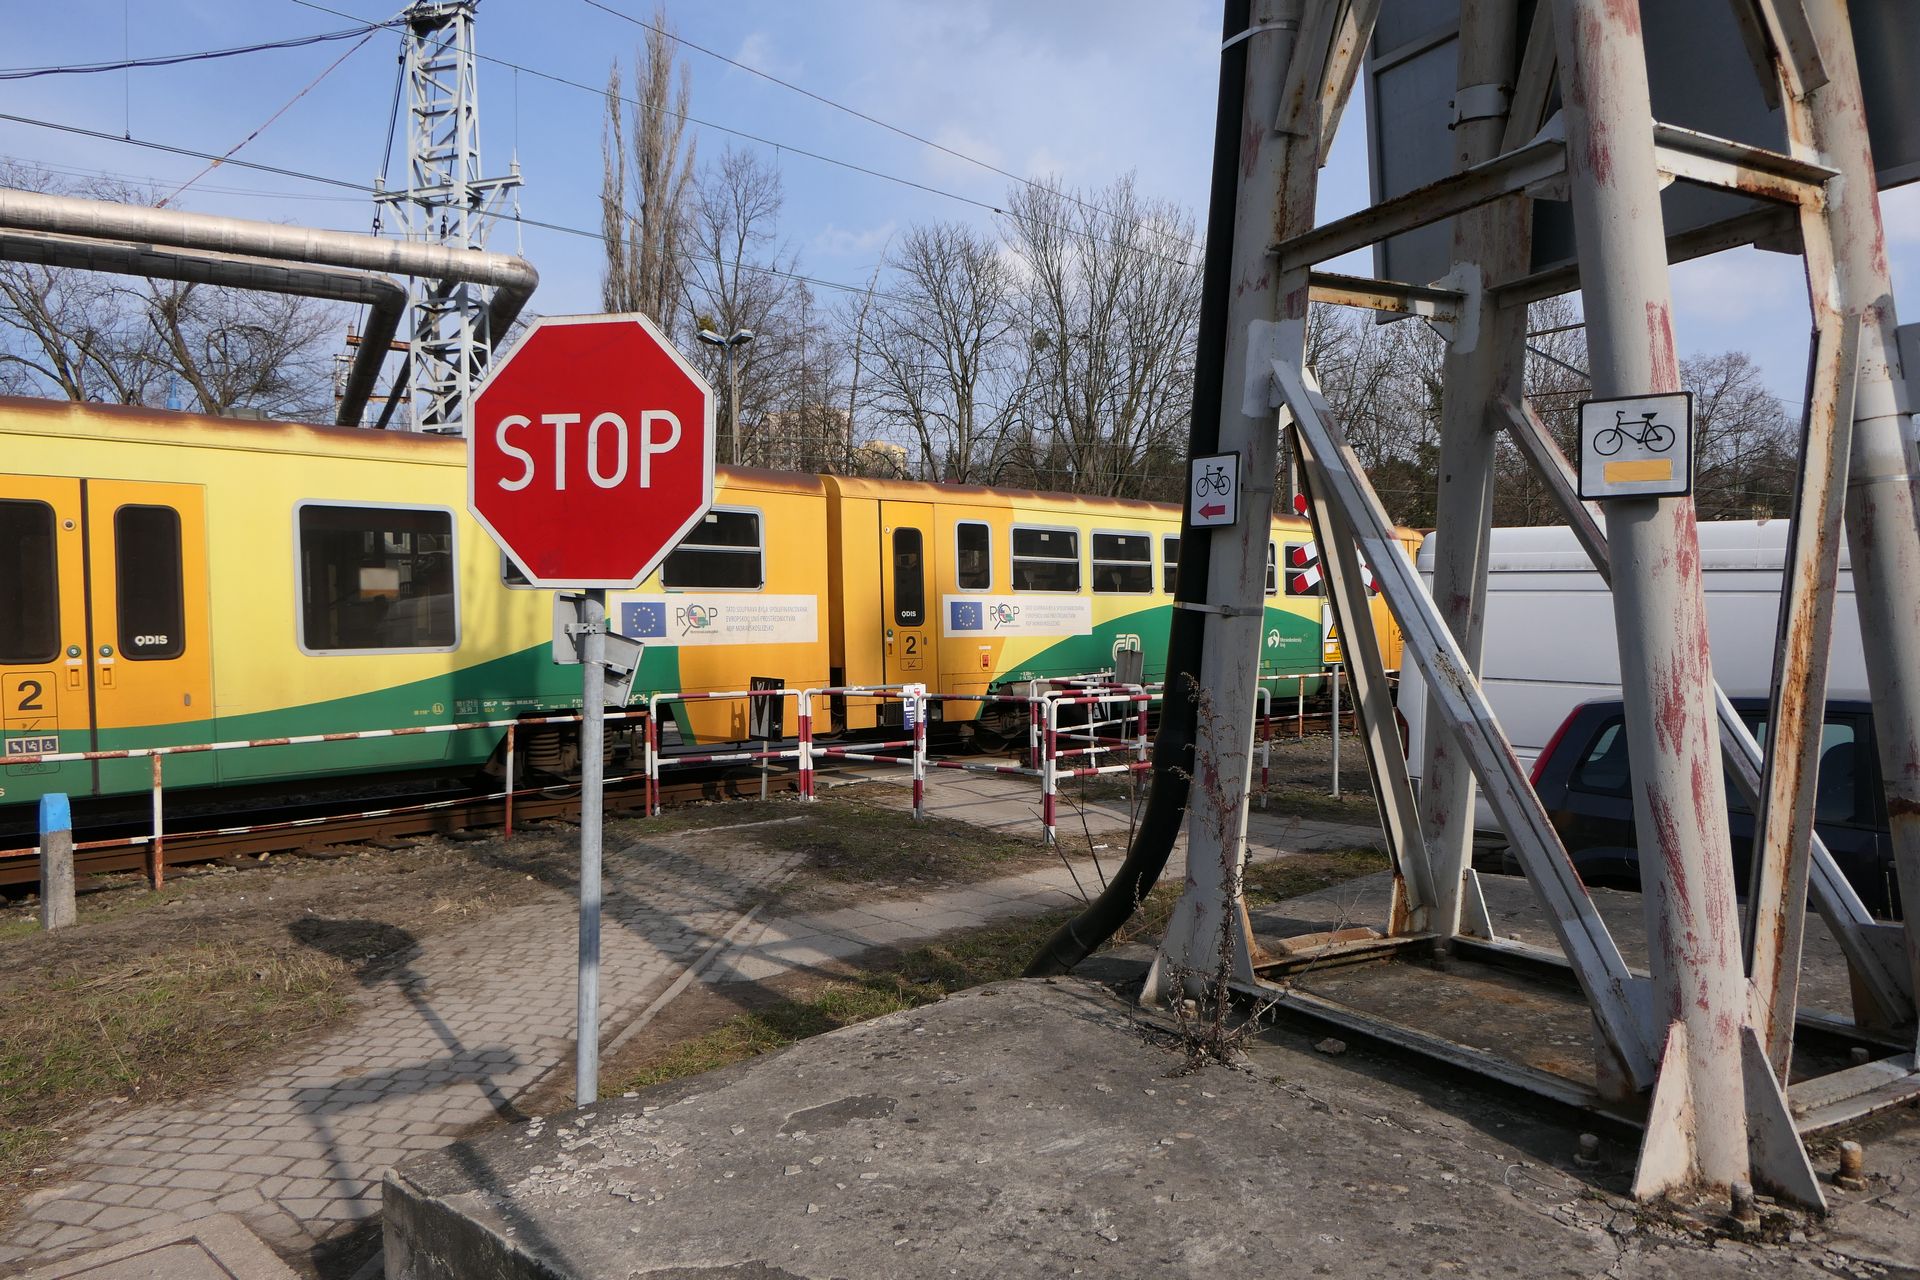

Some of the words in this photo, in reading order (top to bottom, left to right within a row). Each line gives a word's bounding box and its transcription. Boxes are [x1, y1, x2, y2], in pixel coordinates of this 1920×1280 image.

[496, 410, 682, 491] STOP
[905, 635, 917, 654] 2
[17, 680, 43, 711] 2
